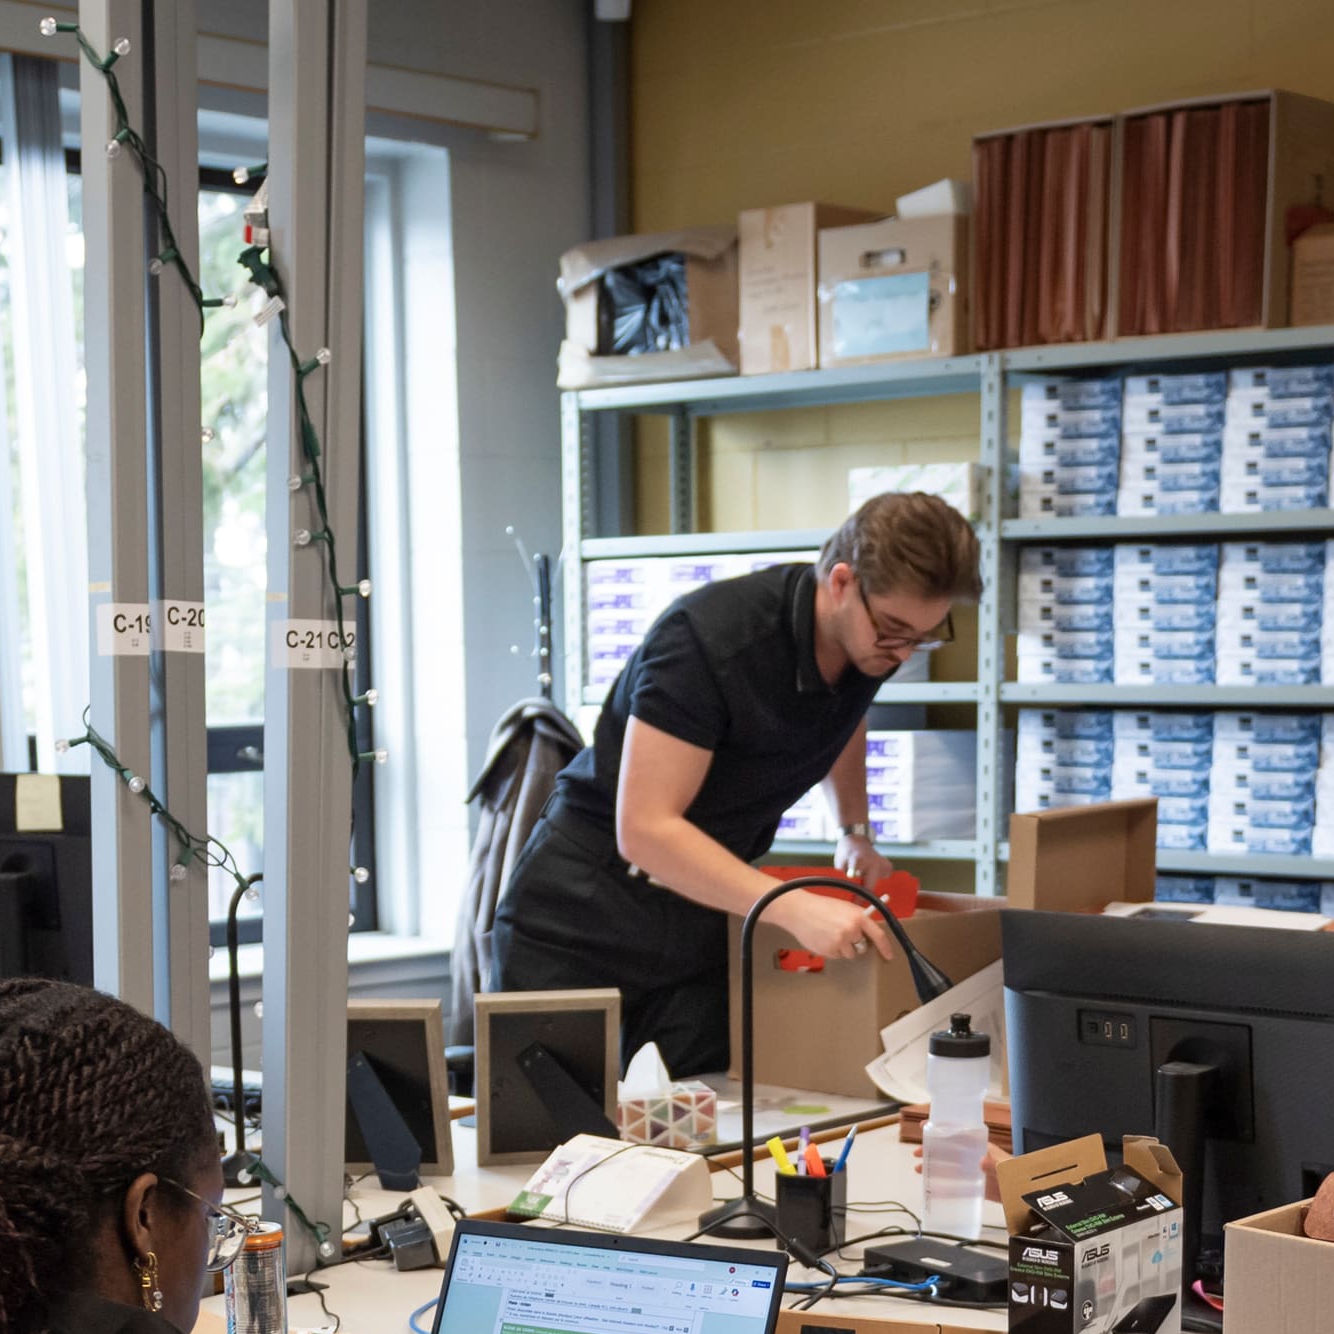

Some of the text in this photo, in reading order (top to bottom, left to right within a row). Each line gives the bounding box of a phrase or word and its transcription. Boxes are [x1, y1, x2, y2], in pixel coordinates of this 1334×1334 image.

[113, 614, 151, 633] C-19
[167, 606, 205, 628] C-20
[286, 630, 323, 648] C-21
[1022, 1246, 1059, 1261] ASUS
[1081, 1243, 1110, 1263] ASUS
